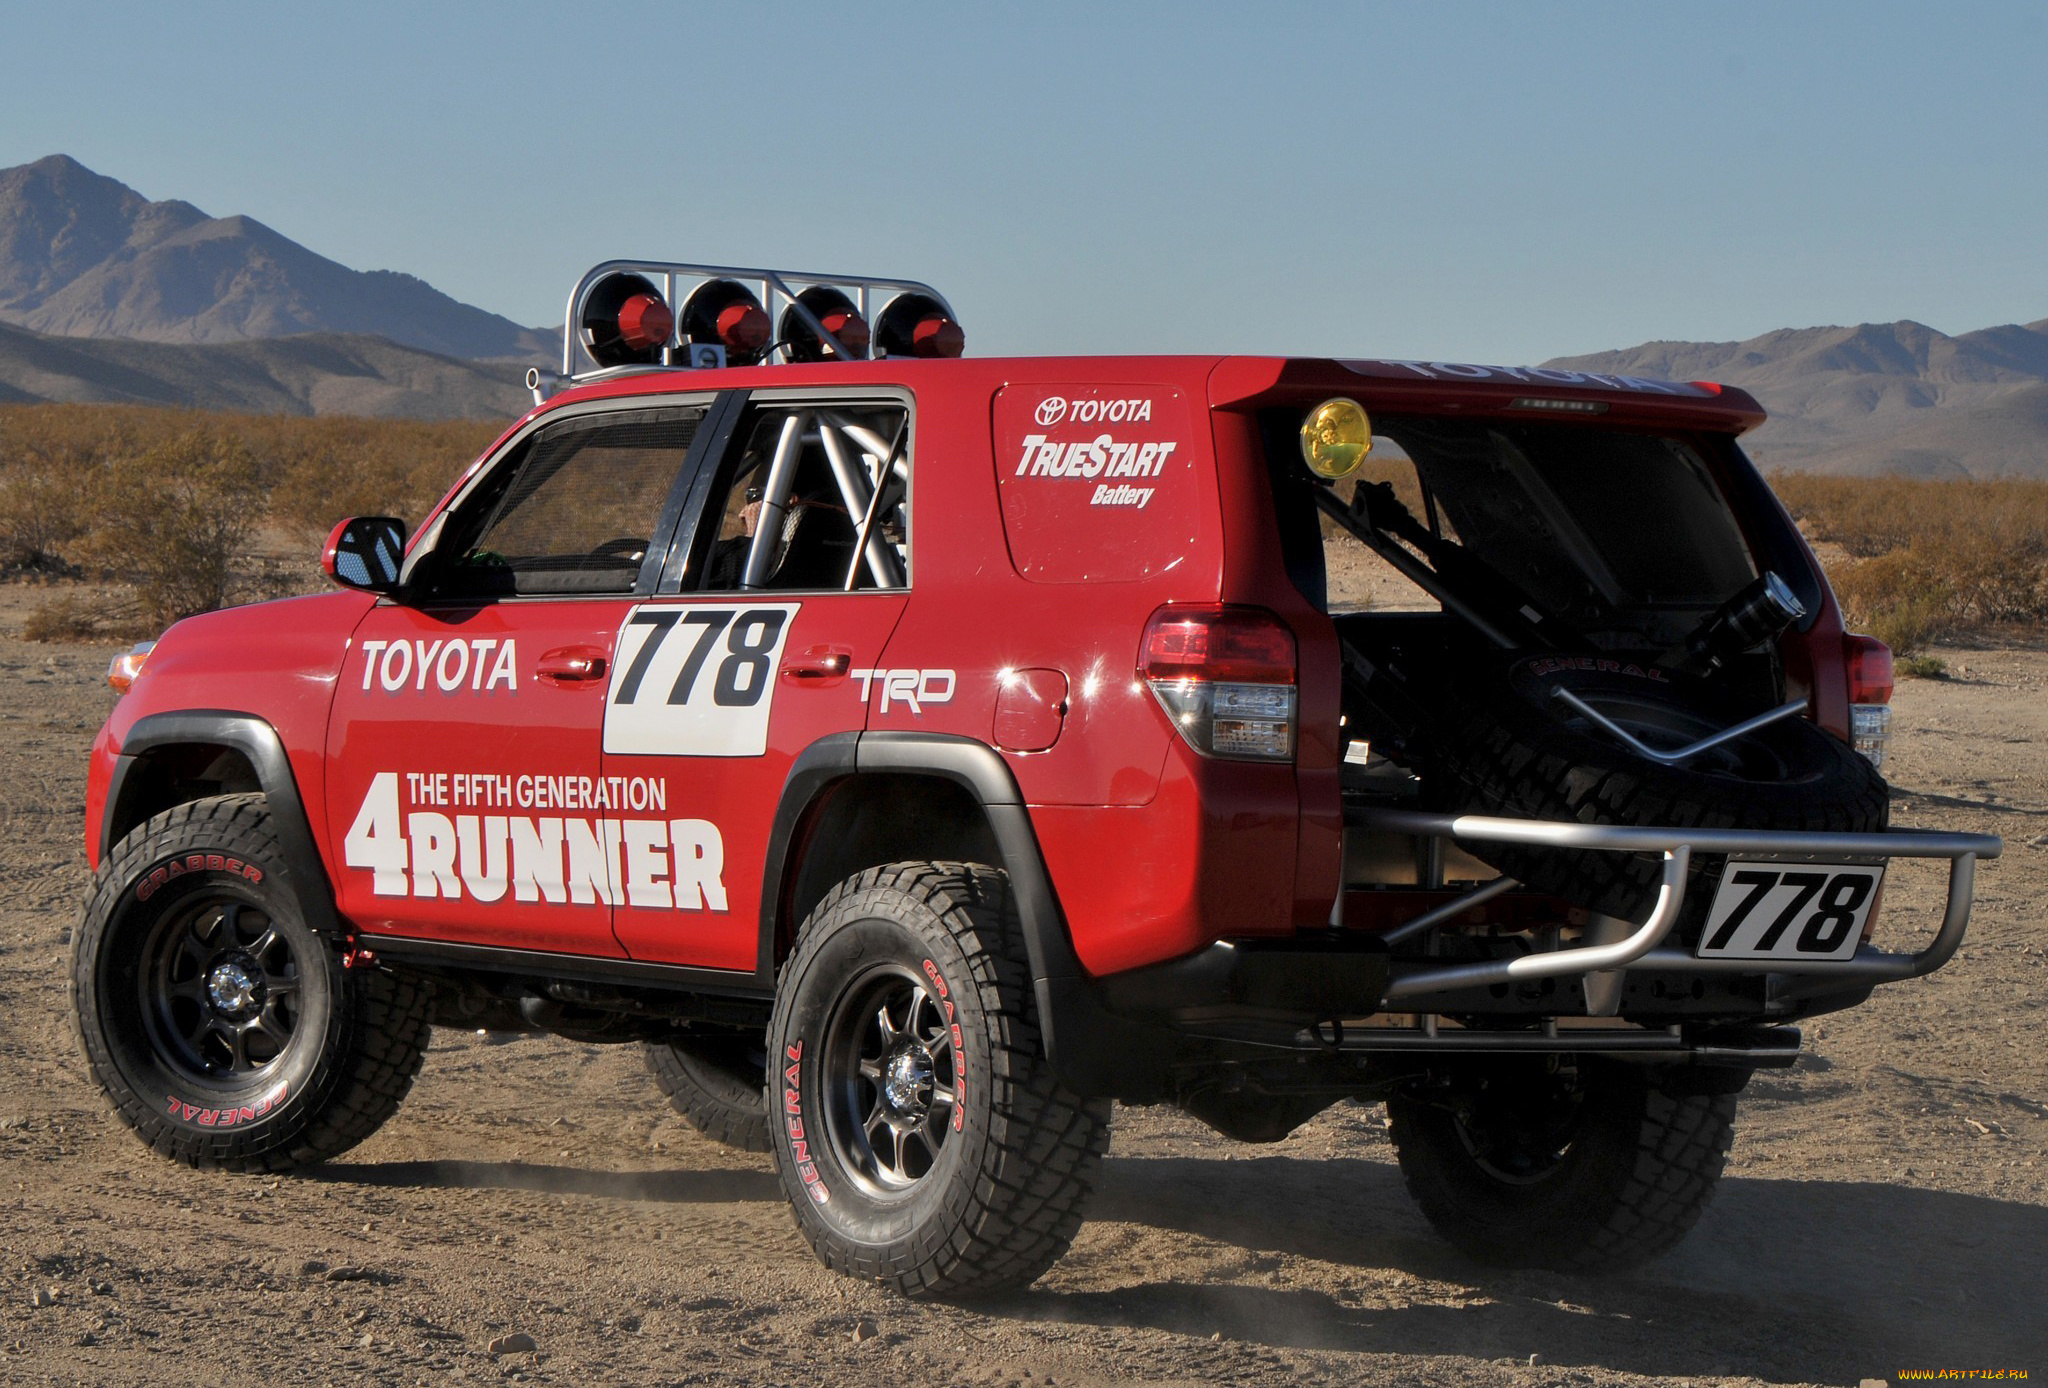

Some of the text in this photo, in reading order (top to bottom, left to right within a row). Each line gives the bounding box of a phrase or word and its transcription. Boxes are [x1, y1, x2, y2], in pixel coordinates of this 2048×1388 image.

[1379, 360, 1676, 394] TOYOTA
[1069, 399, 1151, 422] TOYOTA
[1090, 484, 1155, 508] Battery
[362, 638, 518, 691] TOYOTA
[613, 608, 787, 707] 778
[1529, 657, 1669, 683] GENERAL
[851, 668, 956, 714] TRD
[407, 773, 666, 811] THE FIFTH GENERATION
[344, 772, 728, 912] 4RUNNER
[136, 854, 263, 900] GRABBER
[1705, 870, 1873, 953] 778
[922, 959, 966, 1132] GRABBER
[166, 1080, 289, 1126] GENERAL
[786, 1040, 831, 1204] GENERAL
